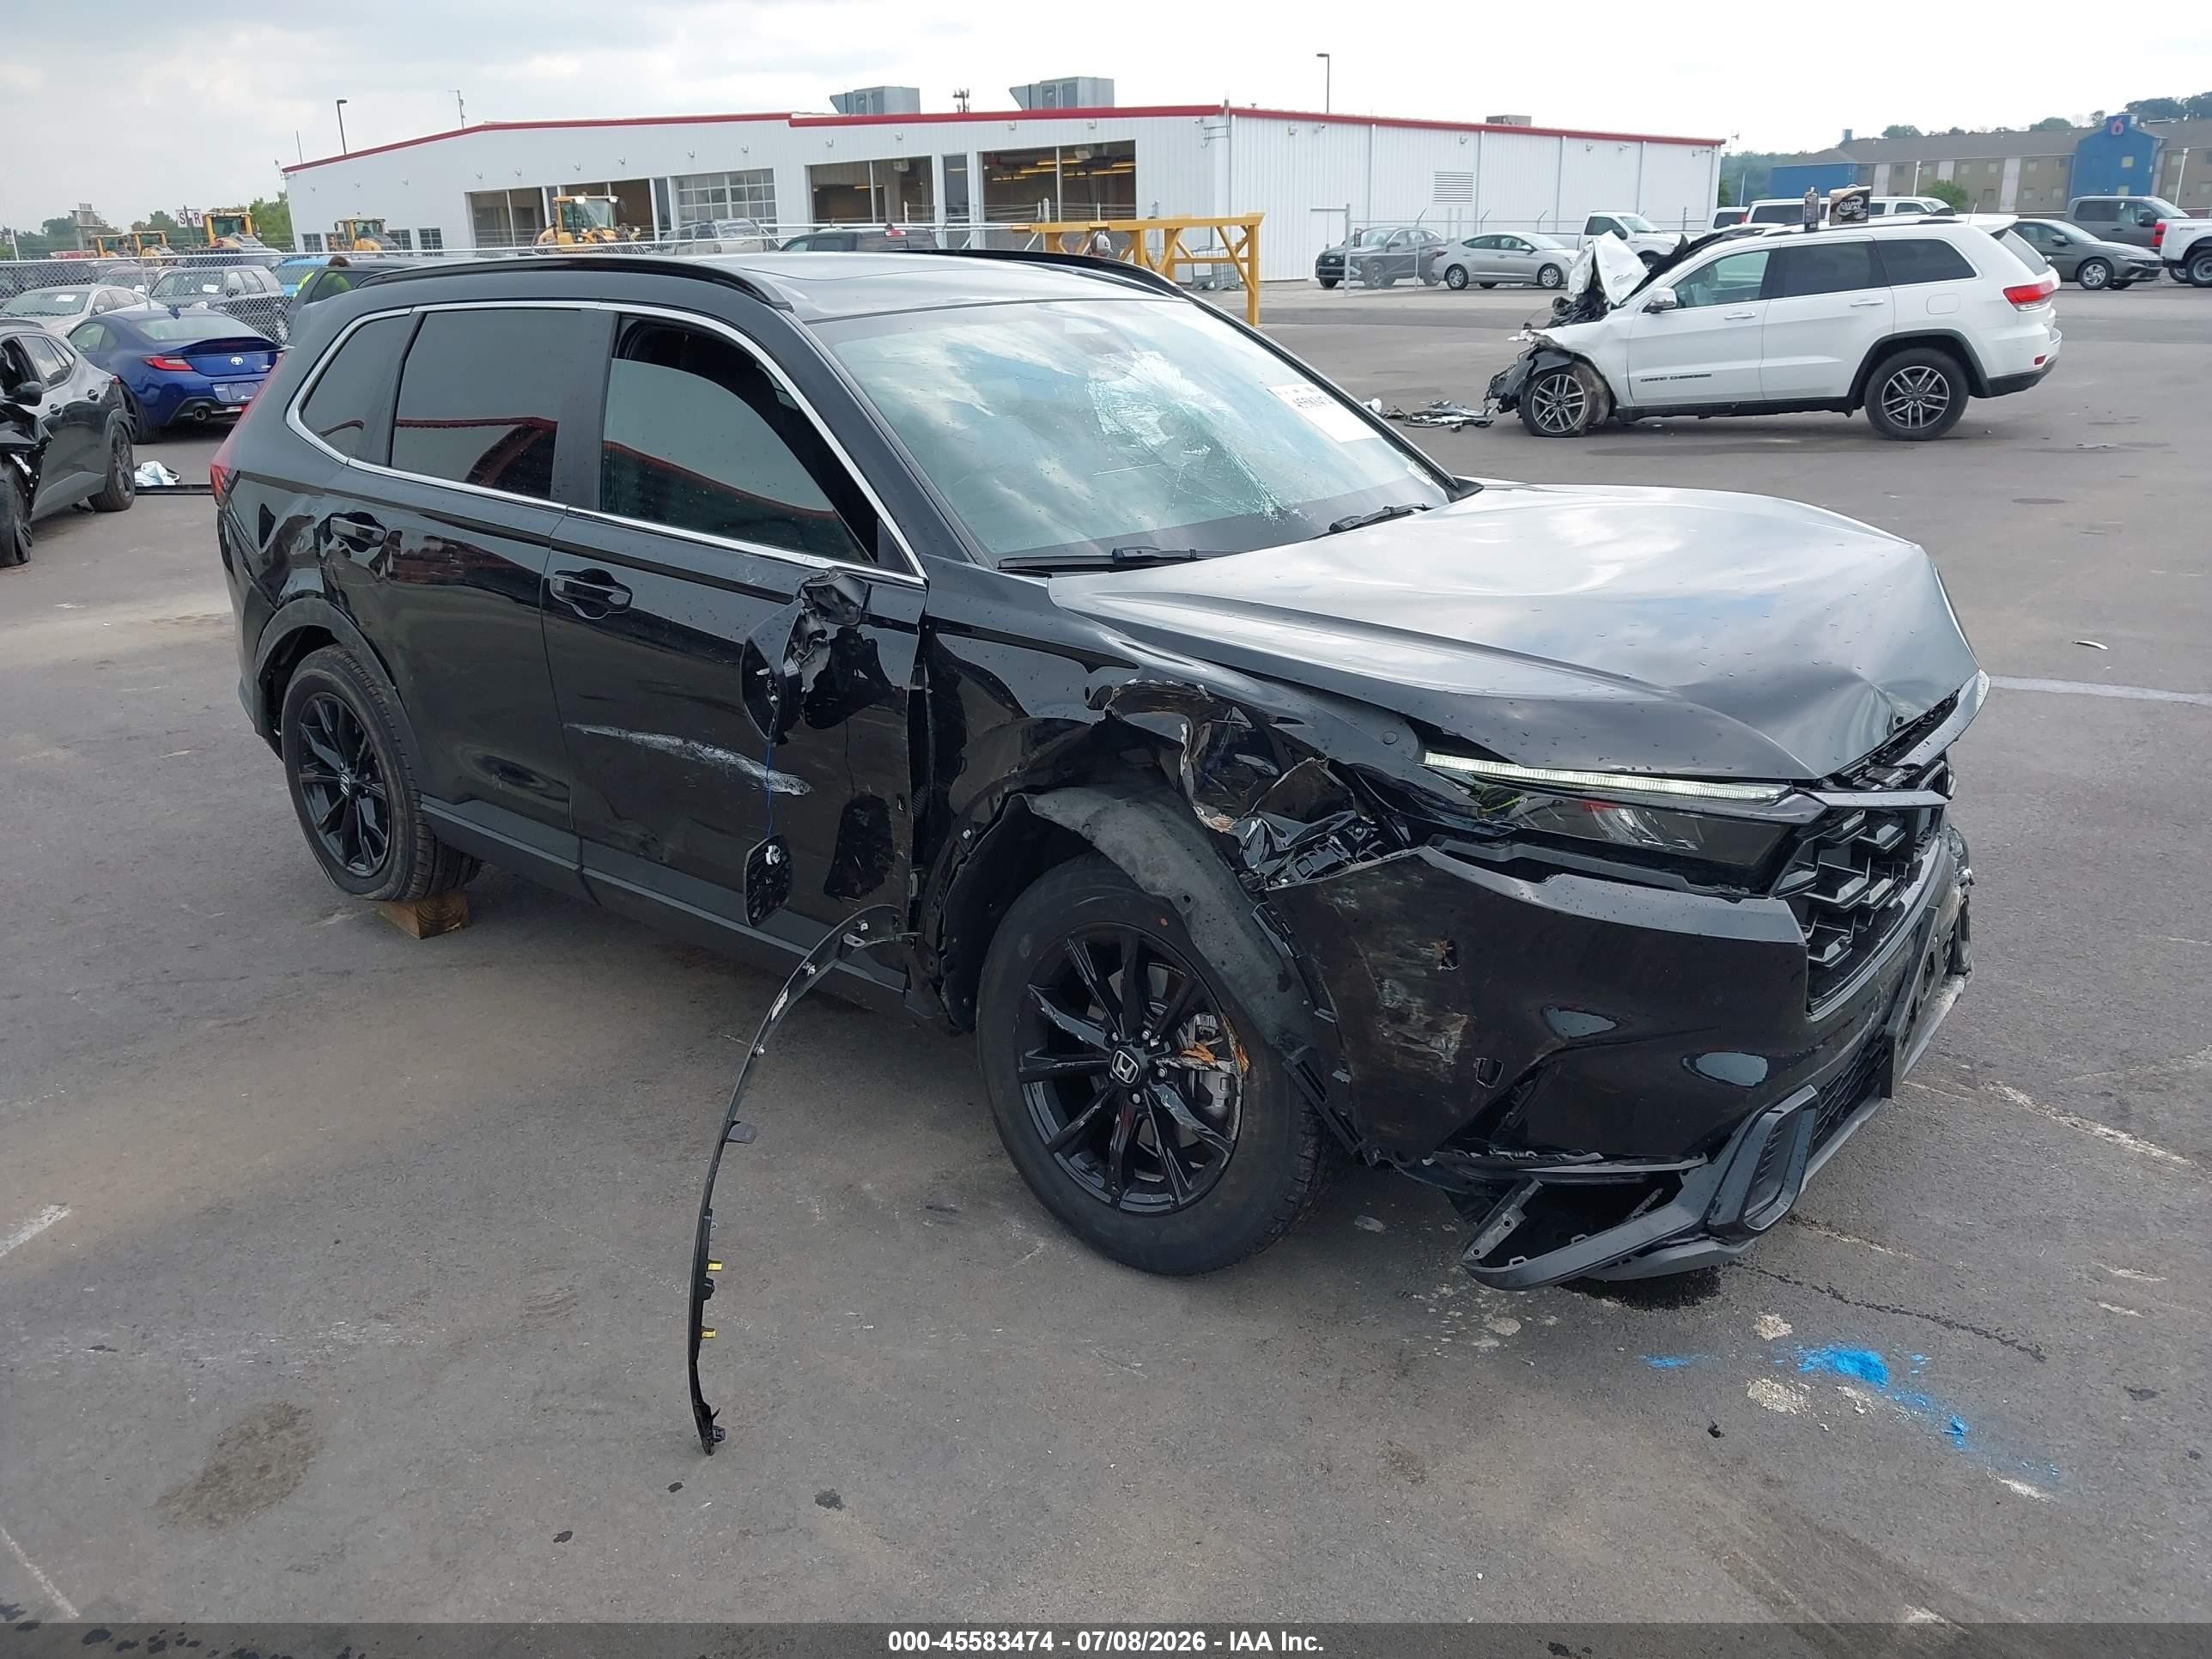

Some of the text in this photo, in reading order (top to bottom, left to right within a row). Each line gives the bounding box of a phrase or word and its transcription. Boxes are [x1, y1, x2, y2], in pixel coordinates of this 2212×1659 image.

[2111, 118, 2124, 136] 6
[179, 212, 201, 225] S R
